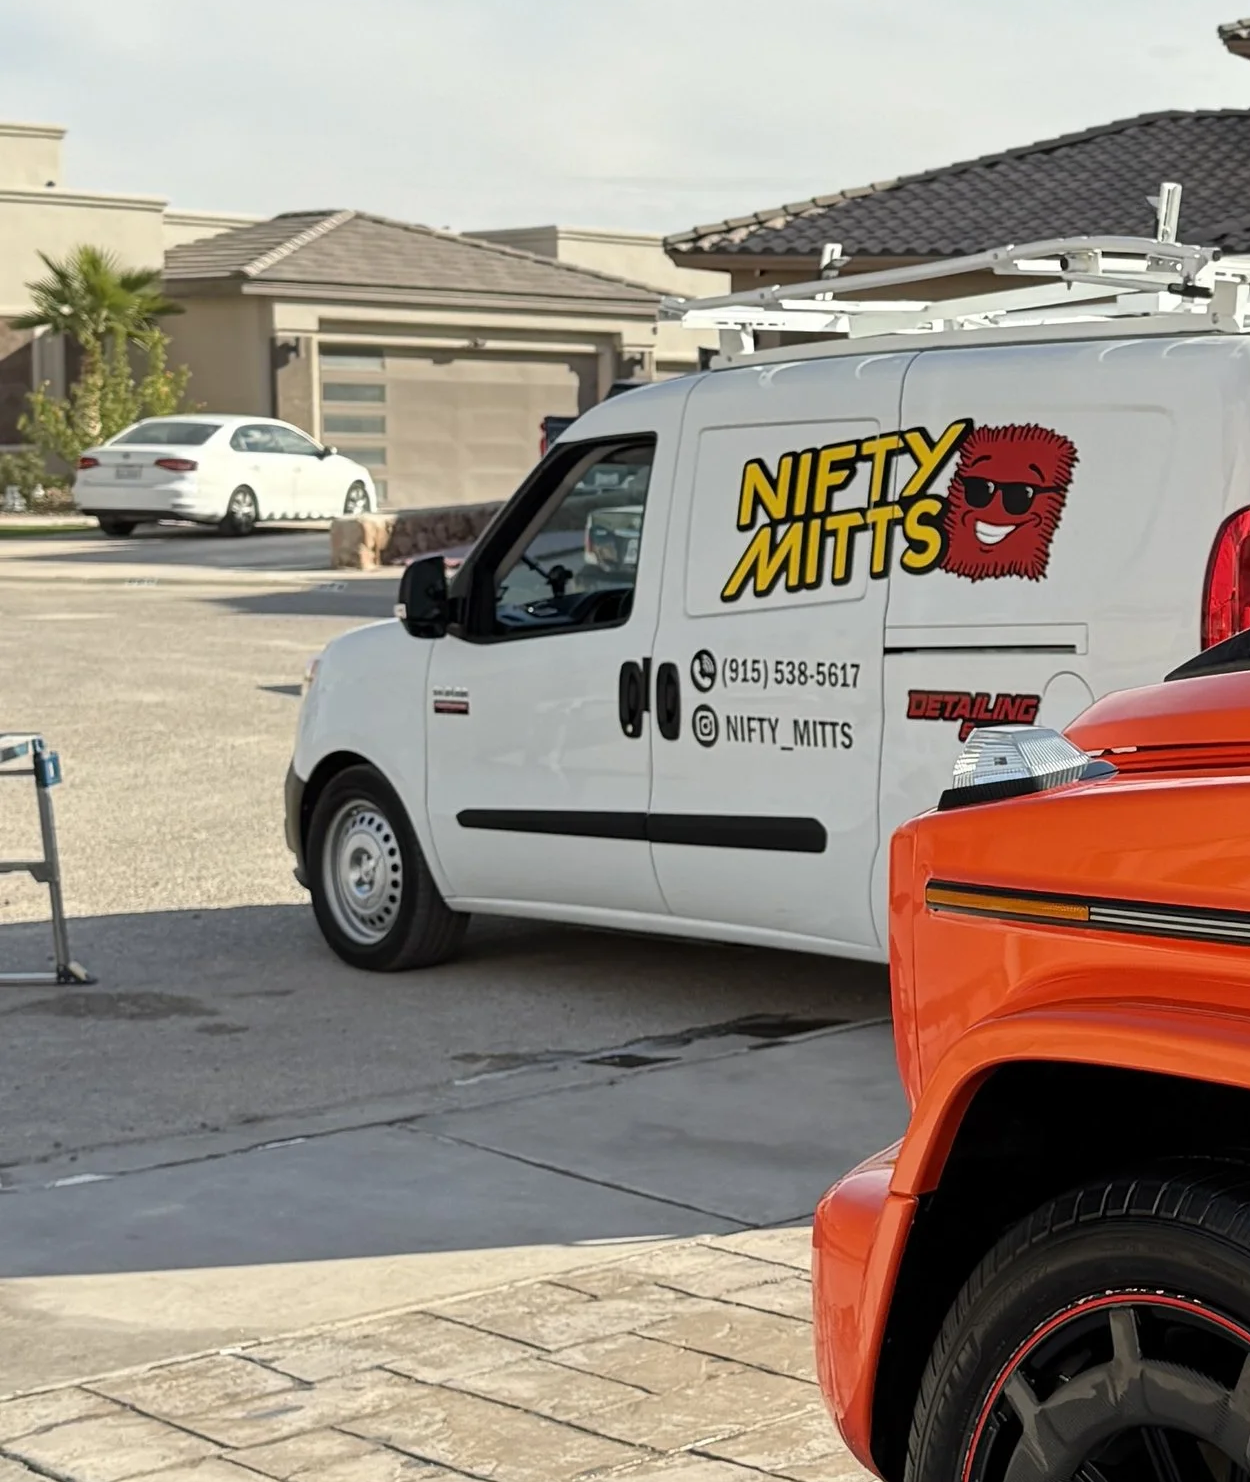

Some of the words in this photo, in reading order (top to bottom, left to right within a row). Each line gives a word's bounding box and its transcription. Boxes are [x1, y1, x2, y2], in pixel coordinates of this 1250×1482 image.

[737, 419, 974, 530] NIFTY
[720, 496, 949, 602] MITTS
[722, 658, 768, 690] (915)
[774, 660, 861, 688] 538-5617
[907, 690, 1041, 725] DETAILING
[725, 715, 854, 751] NIFTY_MITTS
